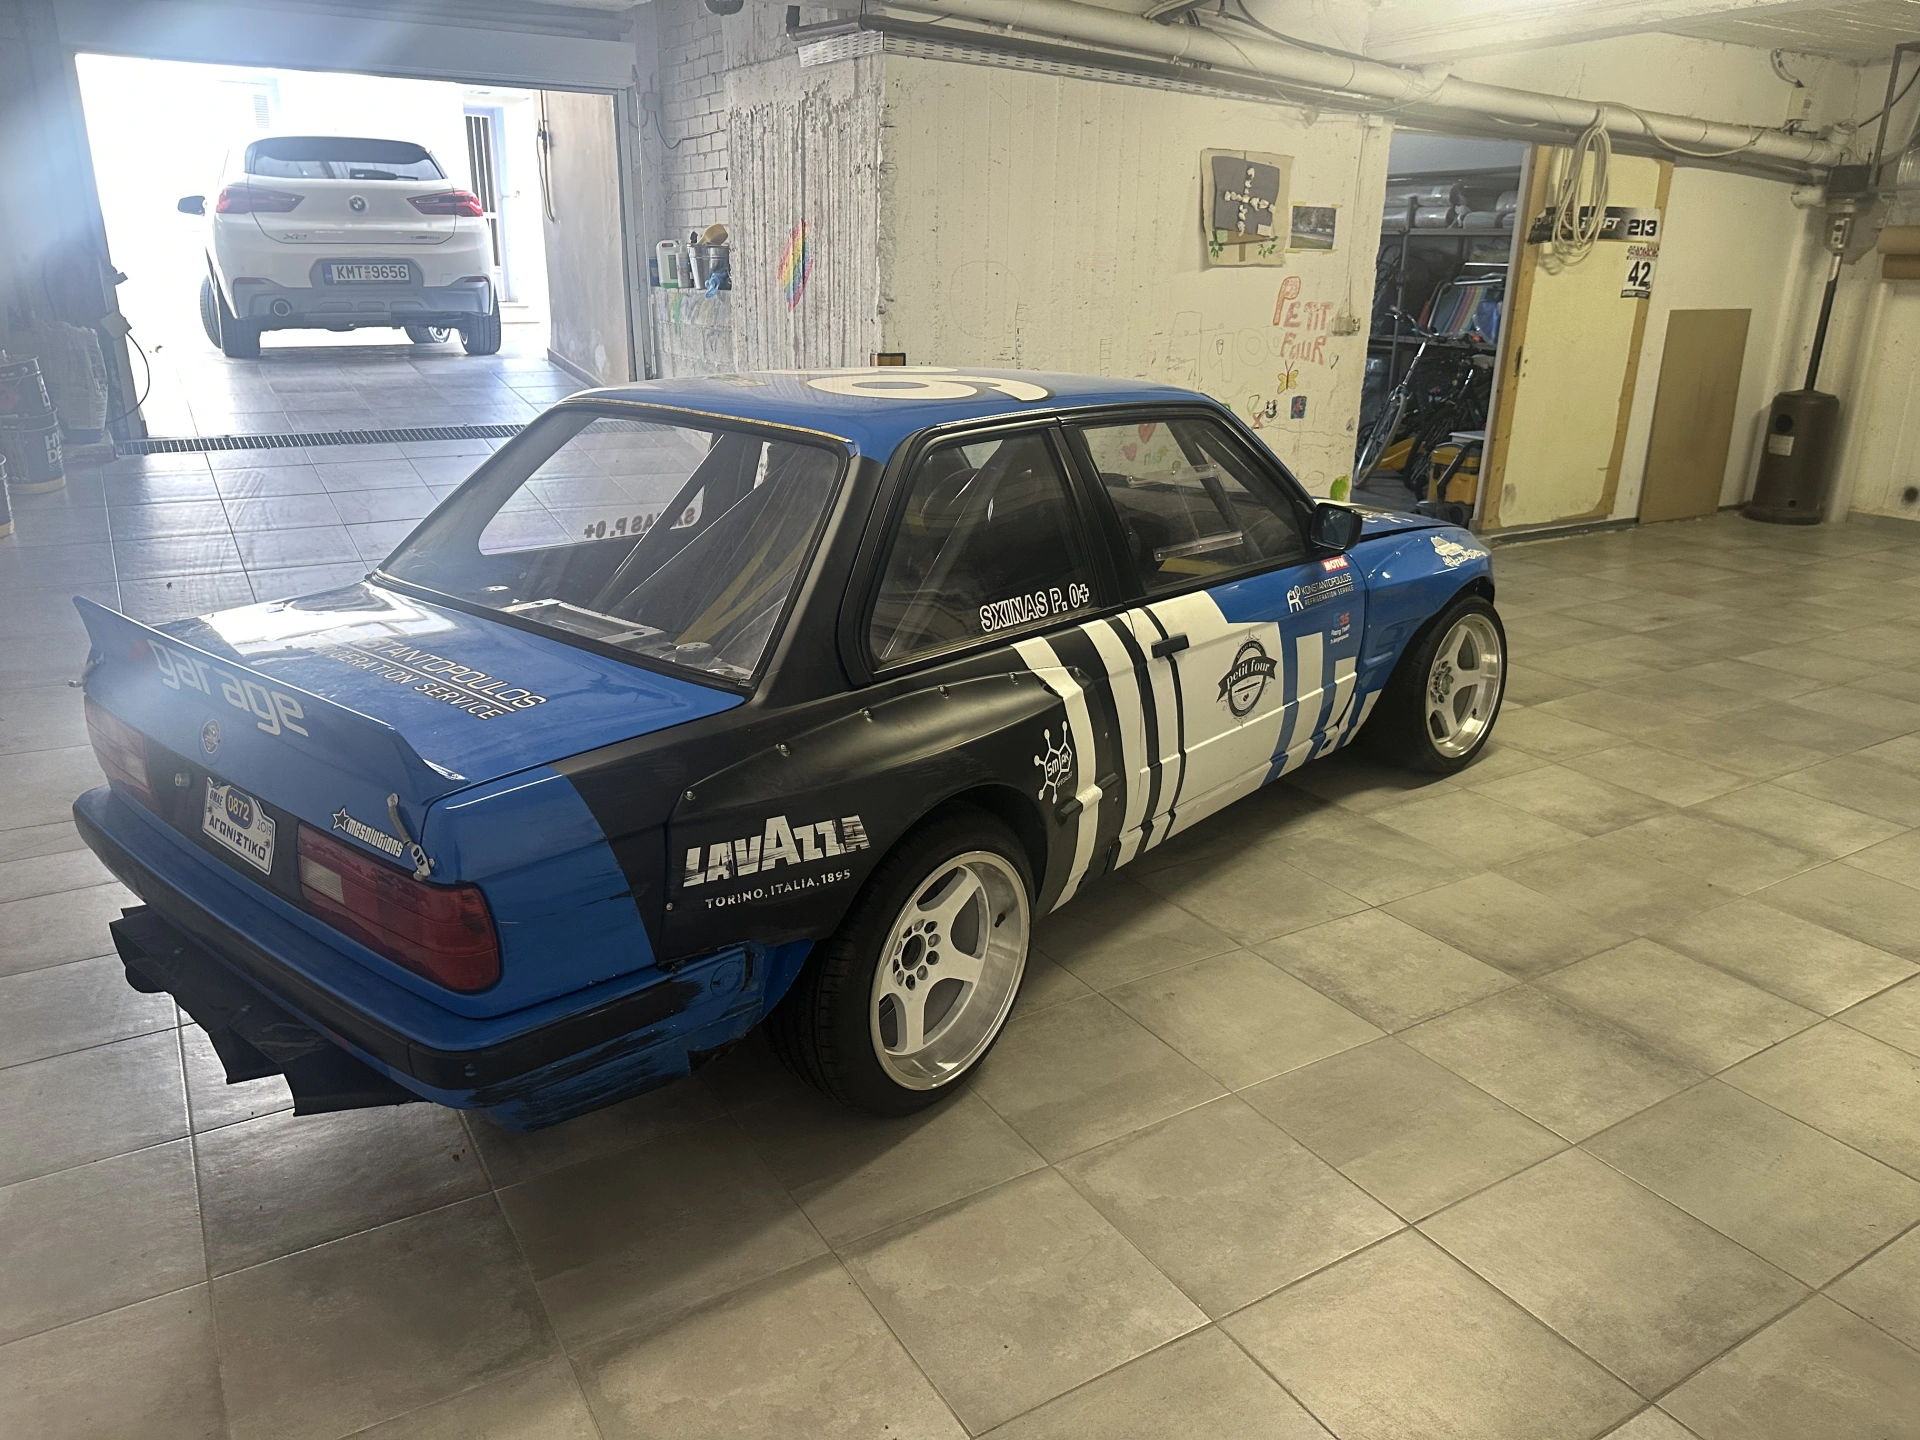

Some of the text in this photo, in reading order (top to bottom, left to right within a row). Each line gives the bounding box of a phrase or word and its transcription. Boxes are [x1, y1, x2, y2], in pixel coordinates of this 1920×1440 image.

[1627, 219, 1658, 237] 213
[1627, 261, 1652, 288] 42
[1323, 557, 1348, 571] MOTUL
[1301, 573, 1352, 596] KONSTANTOPOULOS
[1304, 591, 1338, 606] REFRIGERATION
[1338, 584, 1355, 596] SERVICE
[979, 591, 1049, 632] SXINAS
[1048, 587, 1068, 614] P.
[147, 639, 309, 738] garage
[1226, 659, 1270, 690] petit four
[414, 681, 504, 720] SERVICE
[228, 794, 249, 821] 0872
[209, 814, 266, 861] ΑΓΩΝΙΣΤΙΚΟ
[705, 888, 768, 909] TORINO,
[821, 868, 851, 886] 1895
